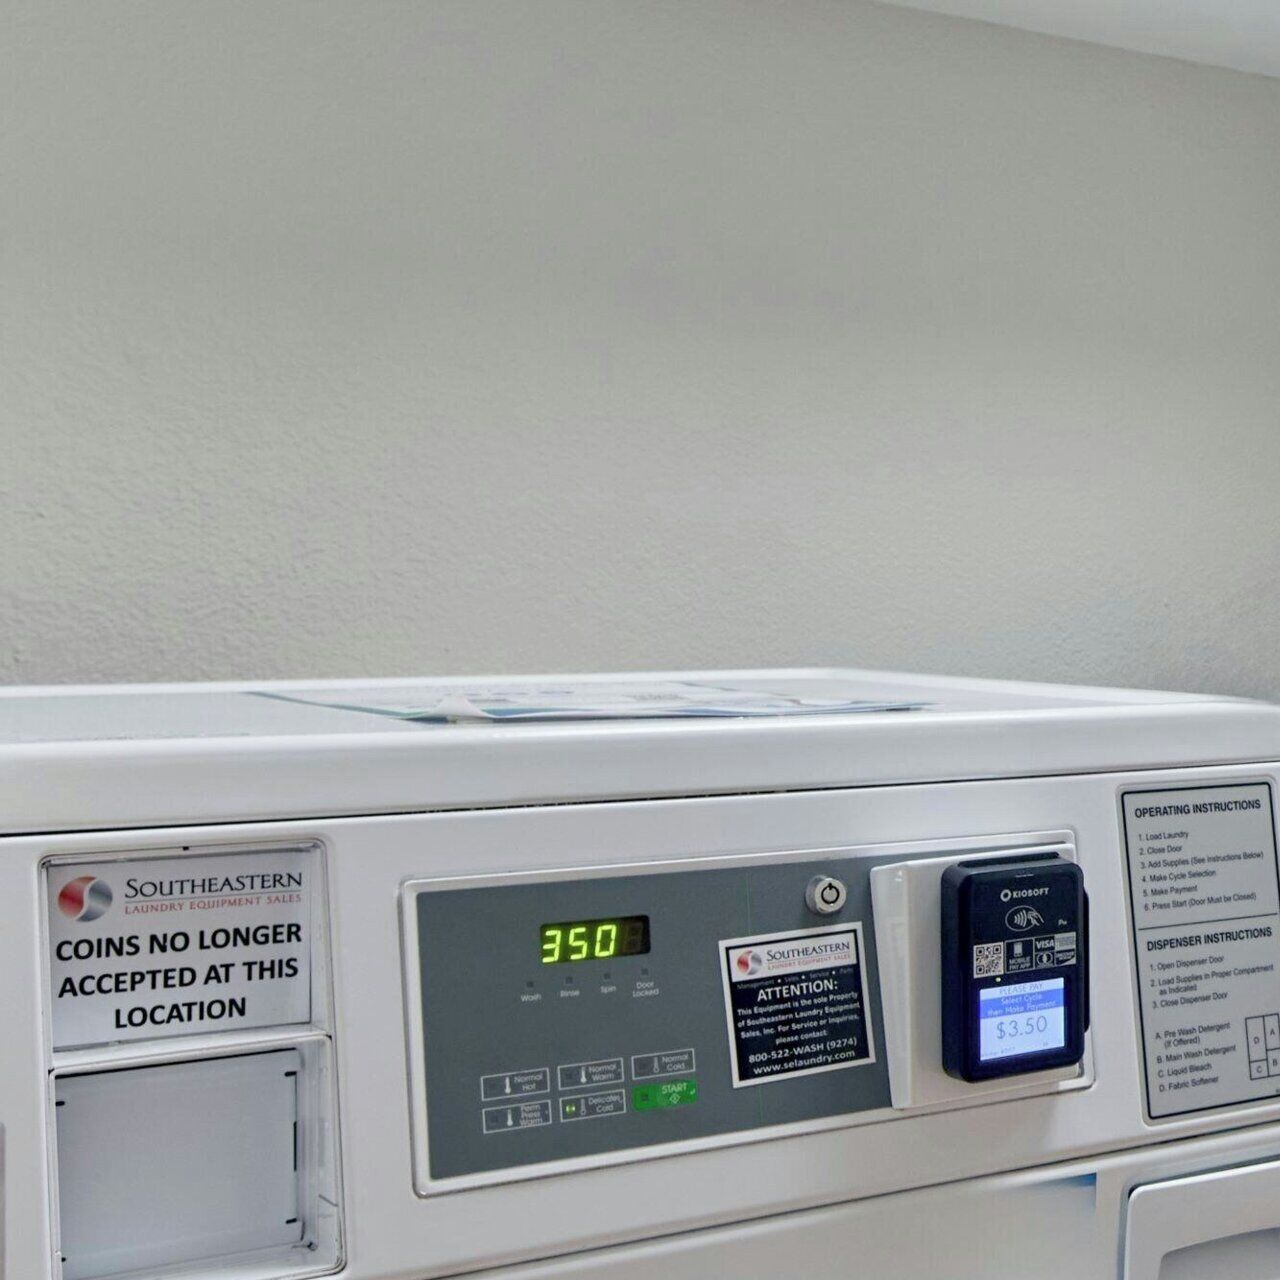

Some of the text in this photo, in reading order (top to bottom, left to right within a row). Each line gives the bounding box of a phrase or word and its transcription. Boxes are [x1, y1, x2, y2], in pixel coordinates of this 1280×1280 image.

[1135, 799, 1261, 818] OPERATING INSTRUCTIONS
[1163, 831, 1189, 840] Laundry
[1167, 845, 1182, 853] Door
[1148, 860, 1161, 868] Add
[1163, 858, 1189, 868] Supplies
[1191, 857, 1205, 865] (See
[1207, 853, 1241, 863] Instructions
[1243, 851, 1263, 860] Below)
[1150, 874, 1167, 882] Make
[1169, 871, 1186, 881] Cycle
[1188, 869, 1216, 878] Selection
[124, 872, 302, 898] SOUTHEASTERN
[1170, 885, 1197, 895] Payment
[1013, 888, 1049, 898] KIOSOFT
[125, 894, 301, 914] LAUNDRY EQUIPMENT SALES
[1152, 901, 1170, 910] Press
[1173, 900, 1187, 908] Start
[1189, 898, 1205, 907] (Door
[1207, 896, 1222, 904] Must
[1233, 892, 1256, 901] Closed)
[56, 923, 302, 961] COINS NO LONGER
[542, 924, 617, 963] 350
[1036, 940, 1054, 949] VISA
[1147, 927, 1272, 951] DISPENSER INSTRUCTIONS
[767, 942, 850, 962] SOUTHEASTERN
[1157, 962, 1174, 971] Open
[1176, 958, 1207, 968] Dispenser
[1209, 956, 1224, 964] Door
[58, 958, 298, 998] ACCEPTED AT THIS
[1159, 978, 1174, 986] Load
[1176, 974, 1203, 984] Supplies
[1212, 969, 1232, 979] Proper
[1234, 964, 1273, 976] Compartment
[632, 988, 659, 997] Locked
[757, 979, 838, 1002] ATTENTION:
[1169, 984, 1197, 994] Indicated
[521, 993, 541, 1002] Wash
[754, 1003, 791, 1014] Equipment
[801, 998, 812, 1006] the
[813, 996, 827, 1004] sole
[829, 992, 858, 1002] Property
[1160, 999, 1178, 1007] Close
[1180, 995, 1211, 1005] Dispenser
[1212, 992, 1228, 1000] Door
[115, 997, 246, 1029] LOCATION
[747, 1013, 793, 1026] Southeastern
[795, 1008, 823, 1018] Laundry
[825, 1002, 860, 1014] Equipment
[792, 1021, 818, 1030] Service
[996, 1016, 1047, 1039] $3.50
[1164, 1030, 1176, 1038] Pre
[1178, 1028, 1196, 1037] Wash
[1198, 1023, 1230, 1034] Detergent
[1270, 1028, 1275, 1036] A
[775, 1036, 798, 1046] please
[748, 1037, 857, 1063] 800-522-WASH (9274)
[1166, 1054, 1182, 1062] Main
[1184, 1050, 1203, 1059] Wash
[1204, 1045, 1236, 1056] Detergent
[662, 1054, 689, 1063] Normal
[753, 1051, 855, 1075] www.selaundry.com
[589, 1063, 616, 1073] Normal
[667, 1062, 685, 1071] Cold
[1167, 1067, 1187, 1077] Liquid
[1189, 1063, 1212, 1072] Bleach
[514, 1073, 543, 1082] Normal
[592, 1072, 614, 1081] Warm
[522, 1083, 536, 1091] Hot
[662, 1083, 688, 1093] START
[1169, 1082, 1189, 1091] Fabric
[1191, 1077, 1218, 1087] Softener
[596, 1103, 614, 1112] Cold
[519, 1117, 543, 1126] Warm
